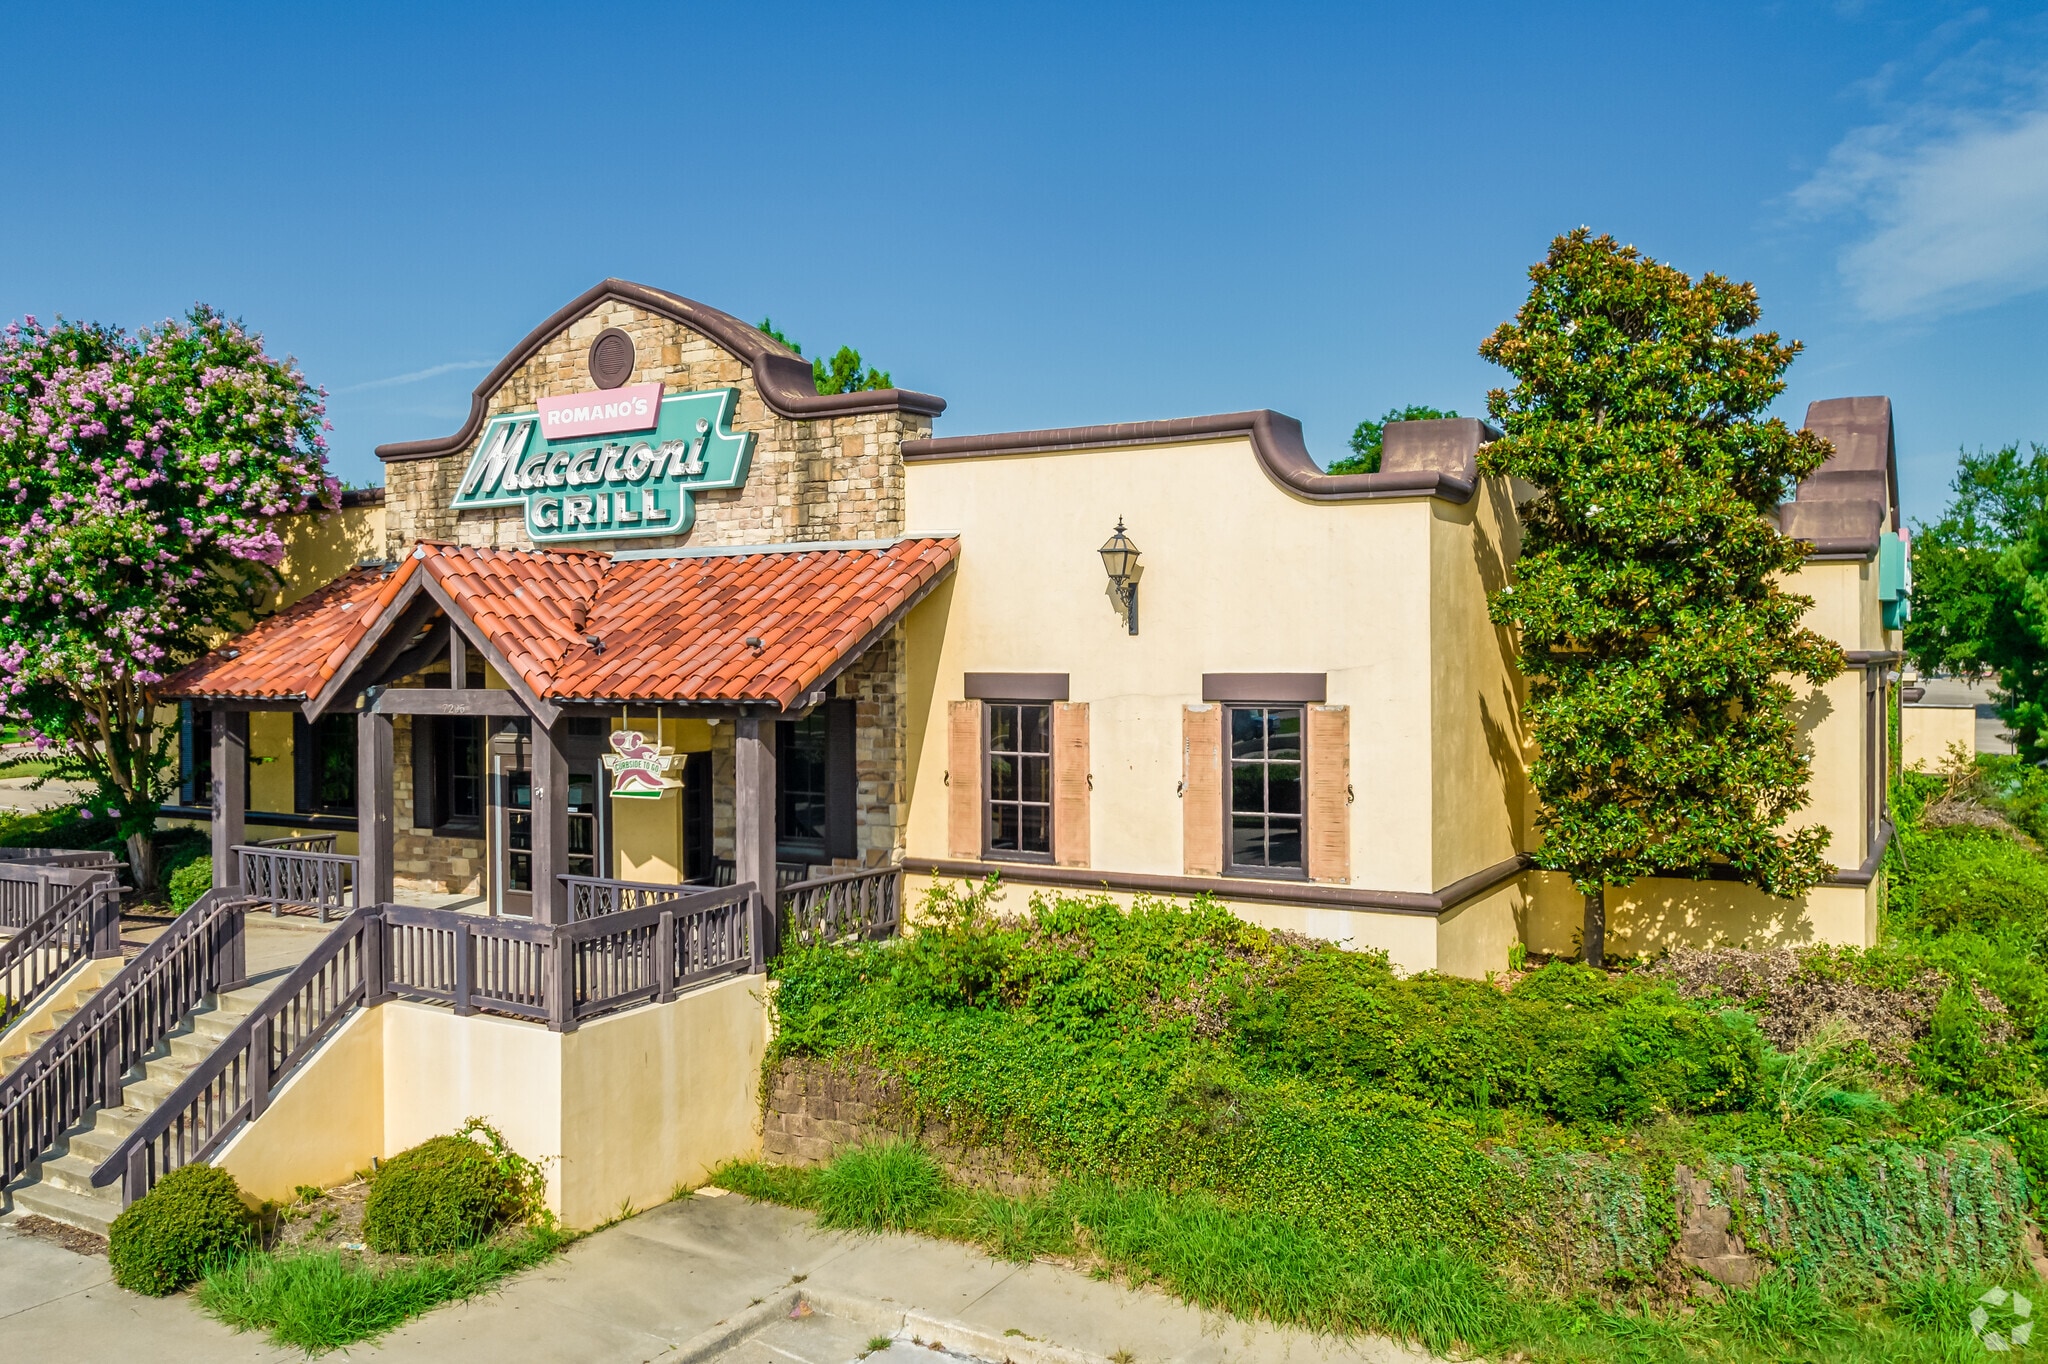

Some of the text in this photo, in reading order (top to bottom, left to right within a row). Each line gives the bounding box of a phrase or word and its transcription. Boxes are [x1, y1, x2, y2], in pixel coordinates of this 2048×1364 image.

[547, 396, 648, 425] ROMANO'S
[463, 417, 708, 494] Macaroni
[531, 489, 670, 528] GRILL
[615, 760, 659, 772] CURBSIDE TO GO
